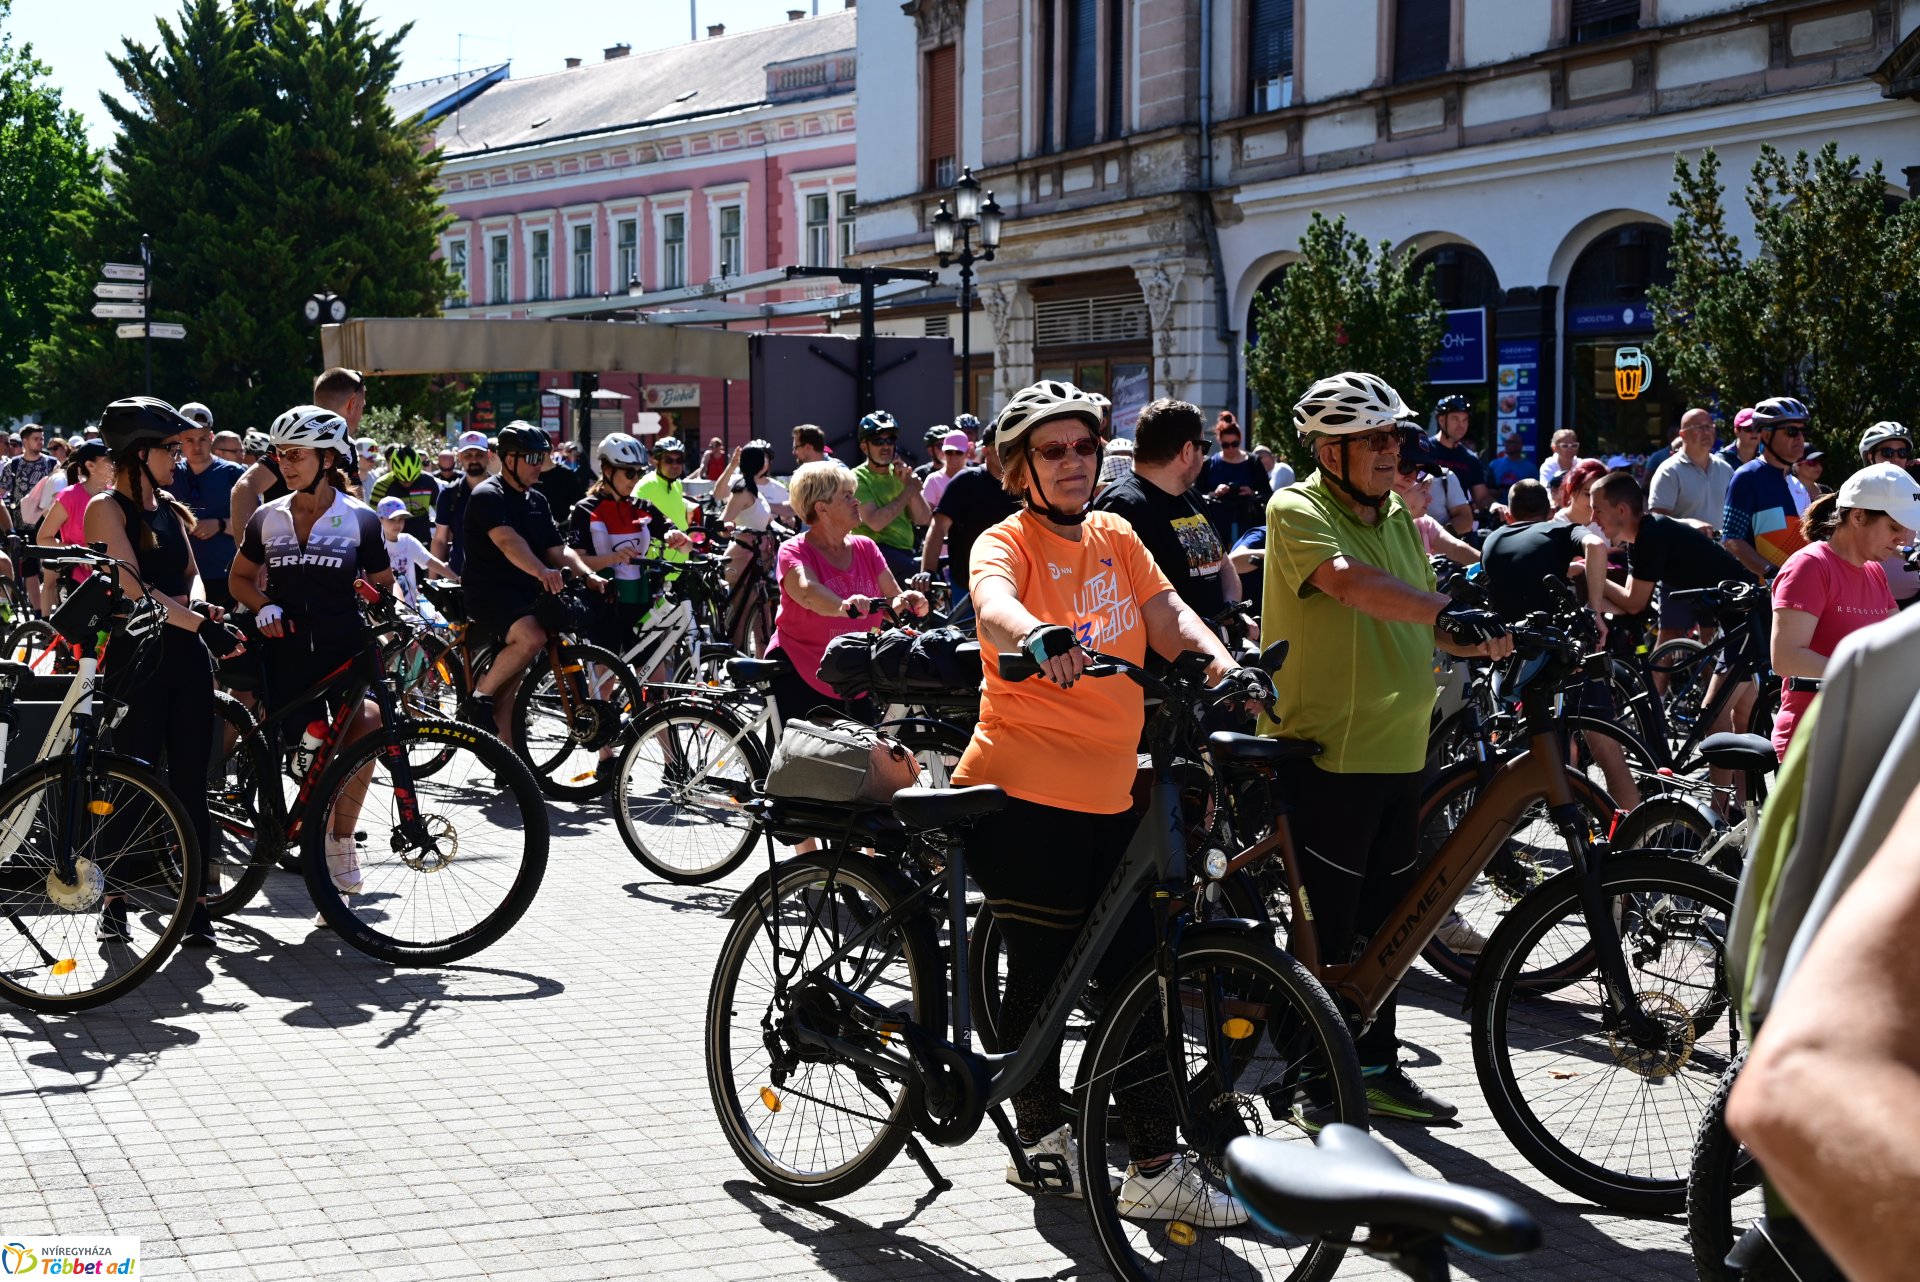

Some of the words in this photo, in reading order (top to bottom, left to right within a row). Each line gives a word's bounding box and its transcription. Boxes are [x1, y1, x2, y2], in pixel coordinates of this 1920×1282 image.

[269, 553, 343, 569] SRAM
[418, 727, 477, 743] MAXXIS
[1101, 853, 1133, 915] FOX
[1377, 865, 1448, 968] ROMET
